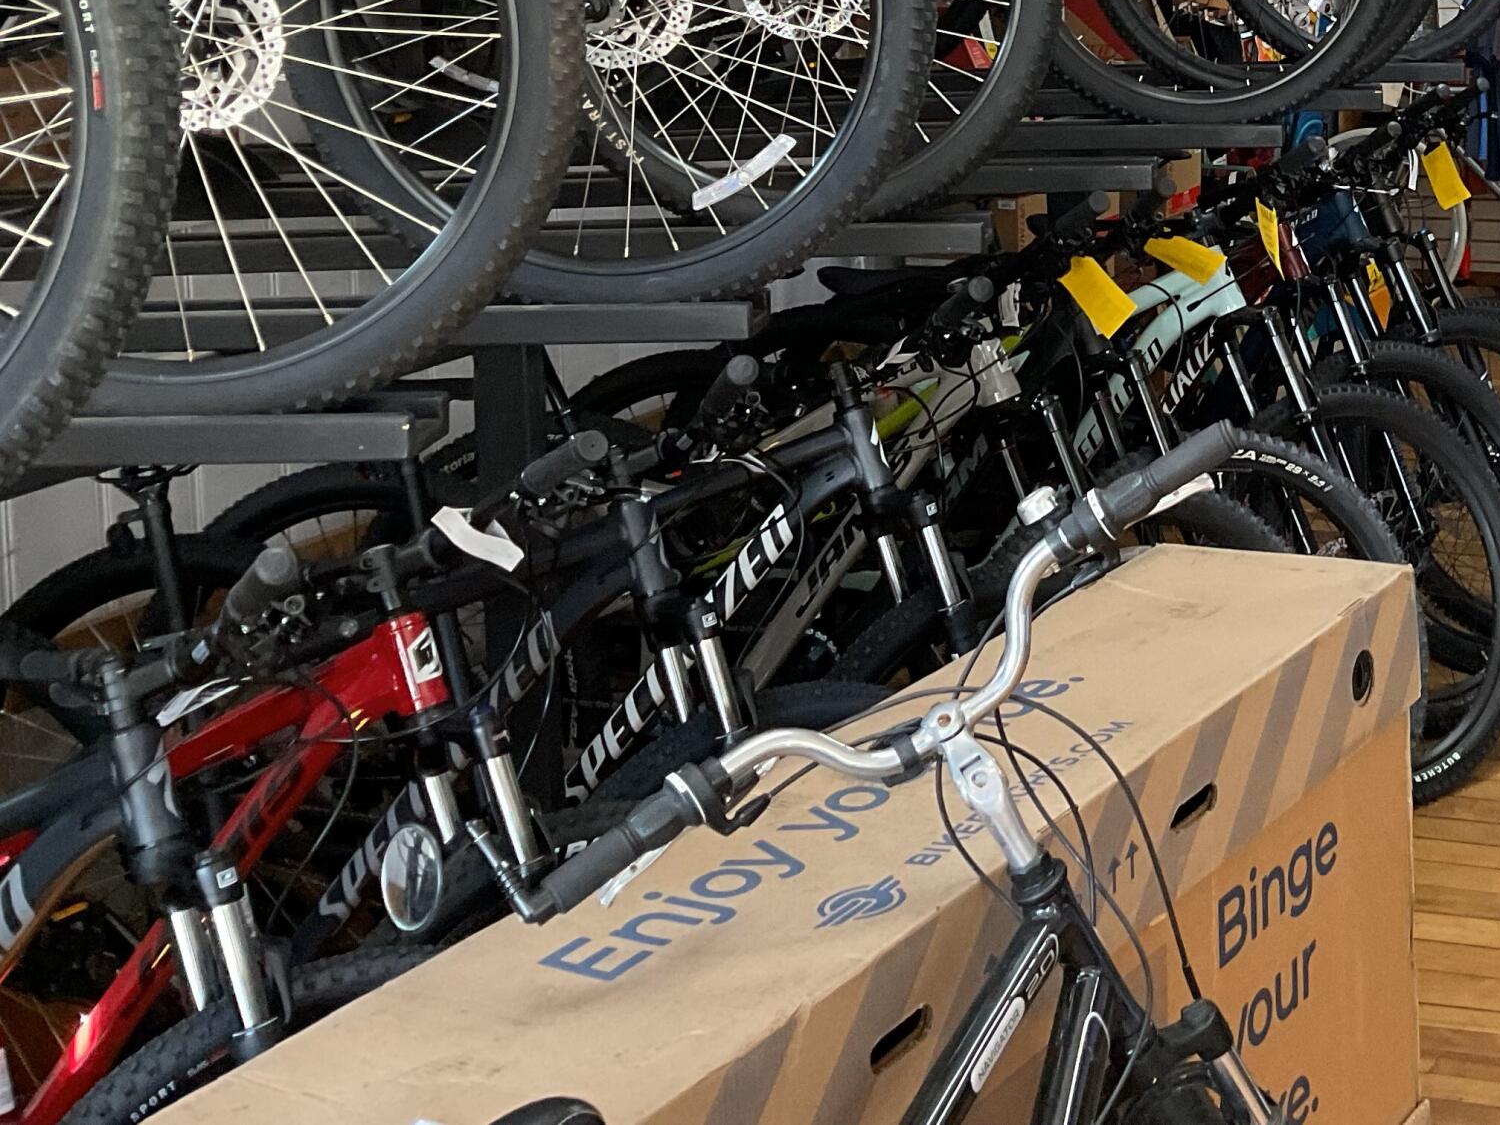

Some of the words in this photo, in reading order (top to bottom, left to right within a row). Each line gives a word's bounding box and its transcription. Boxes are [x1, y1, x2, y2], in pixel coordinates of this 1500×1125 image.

[1413, 751, 1461, 783] BUTCHER
[538, 839, 806, 982] Enjoy
[1218, 821, 1339, 970] Binge
[977, 1008, 1021, 1082] NAVIGATOR
